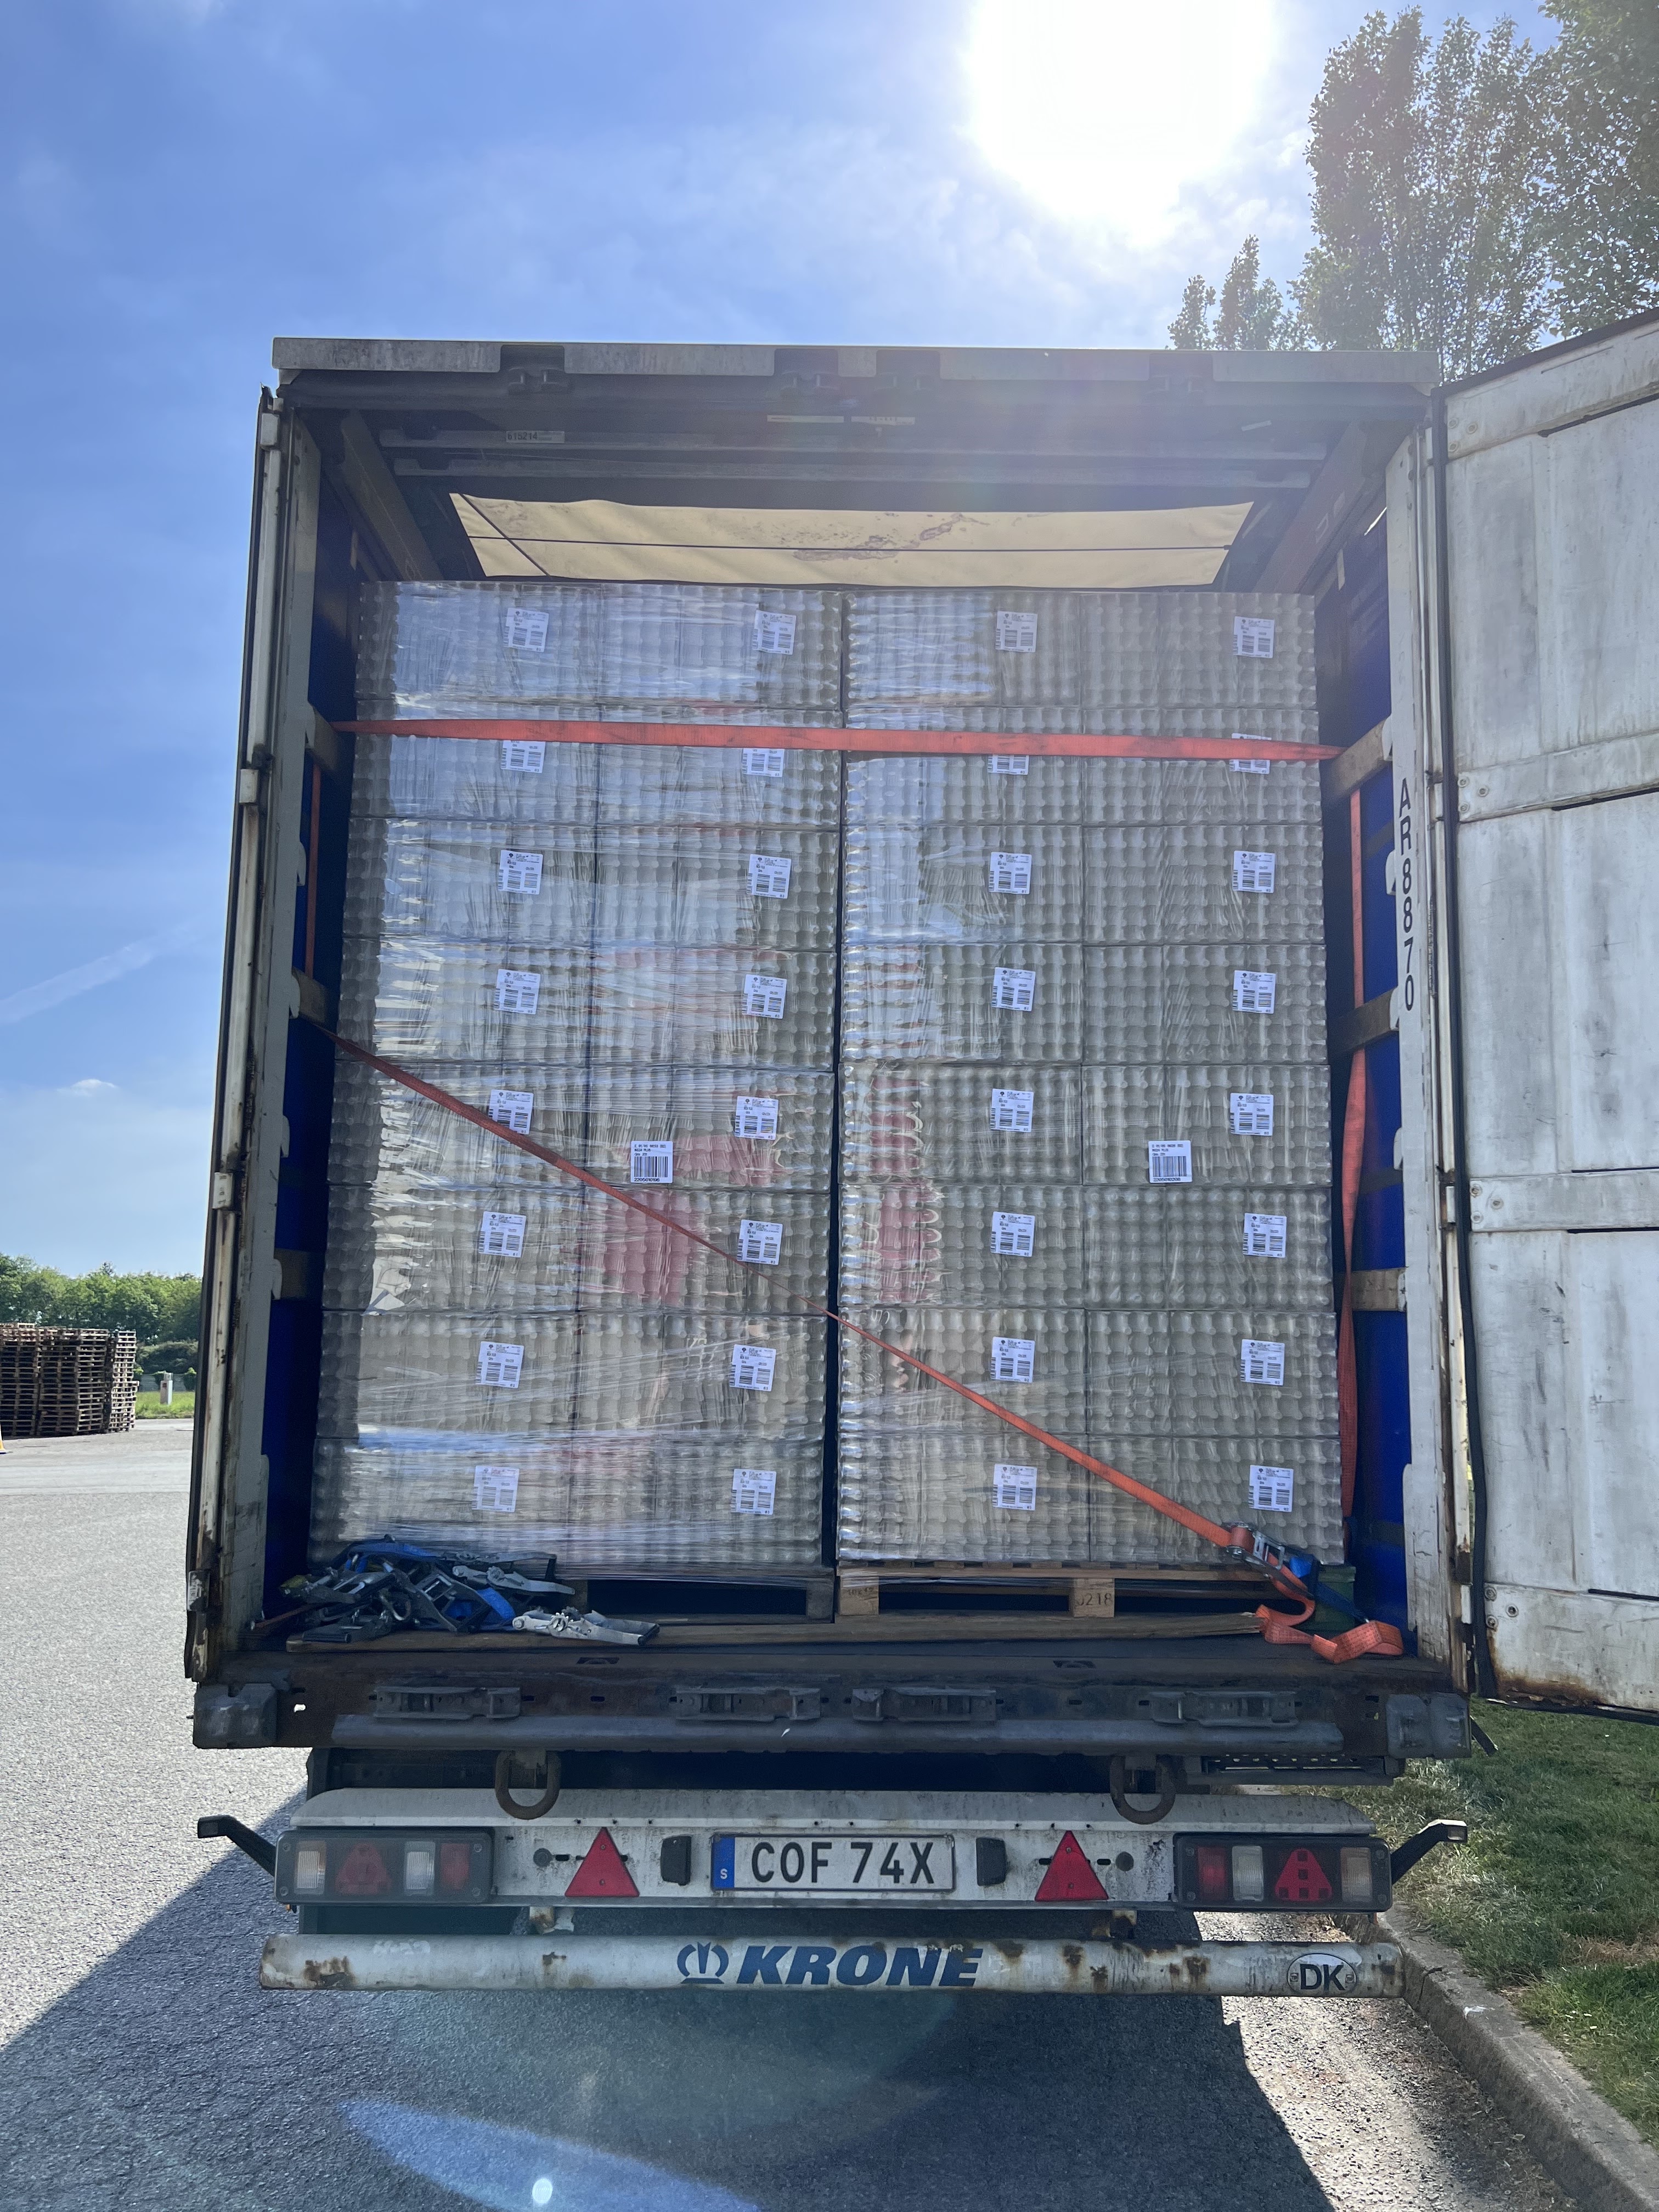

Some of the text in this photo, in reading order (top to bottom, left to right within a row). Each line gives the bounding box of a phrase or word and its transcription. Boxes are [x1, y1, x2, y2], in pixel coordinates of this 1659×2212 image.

[1399, 777, 1414, 1011] AR8870
[720, 1868, 728, 1880] S
[751, 1841, 934, 1884] COF 74X
[737, 1945, 983, 1987] KRONE
[1300, 1963, 1346, 1991] DK
